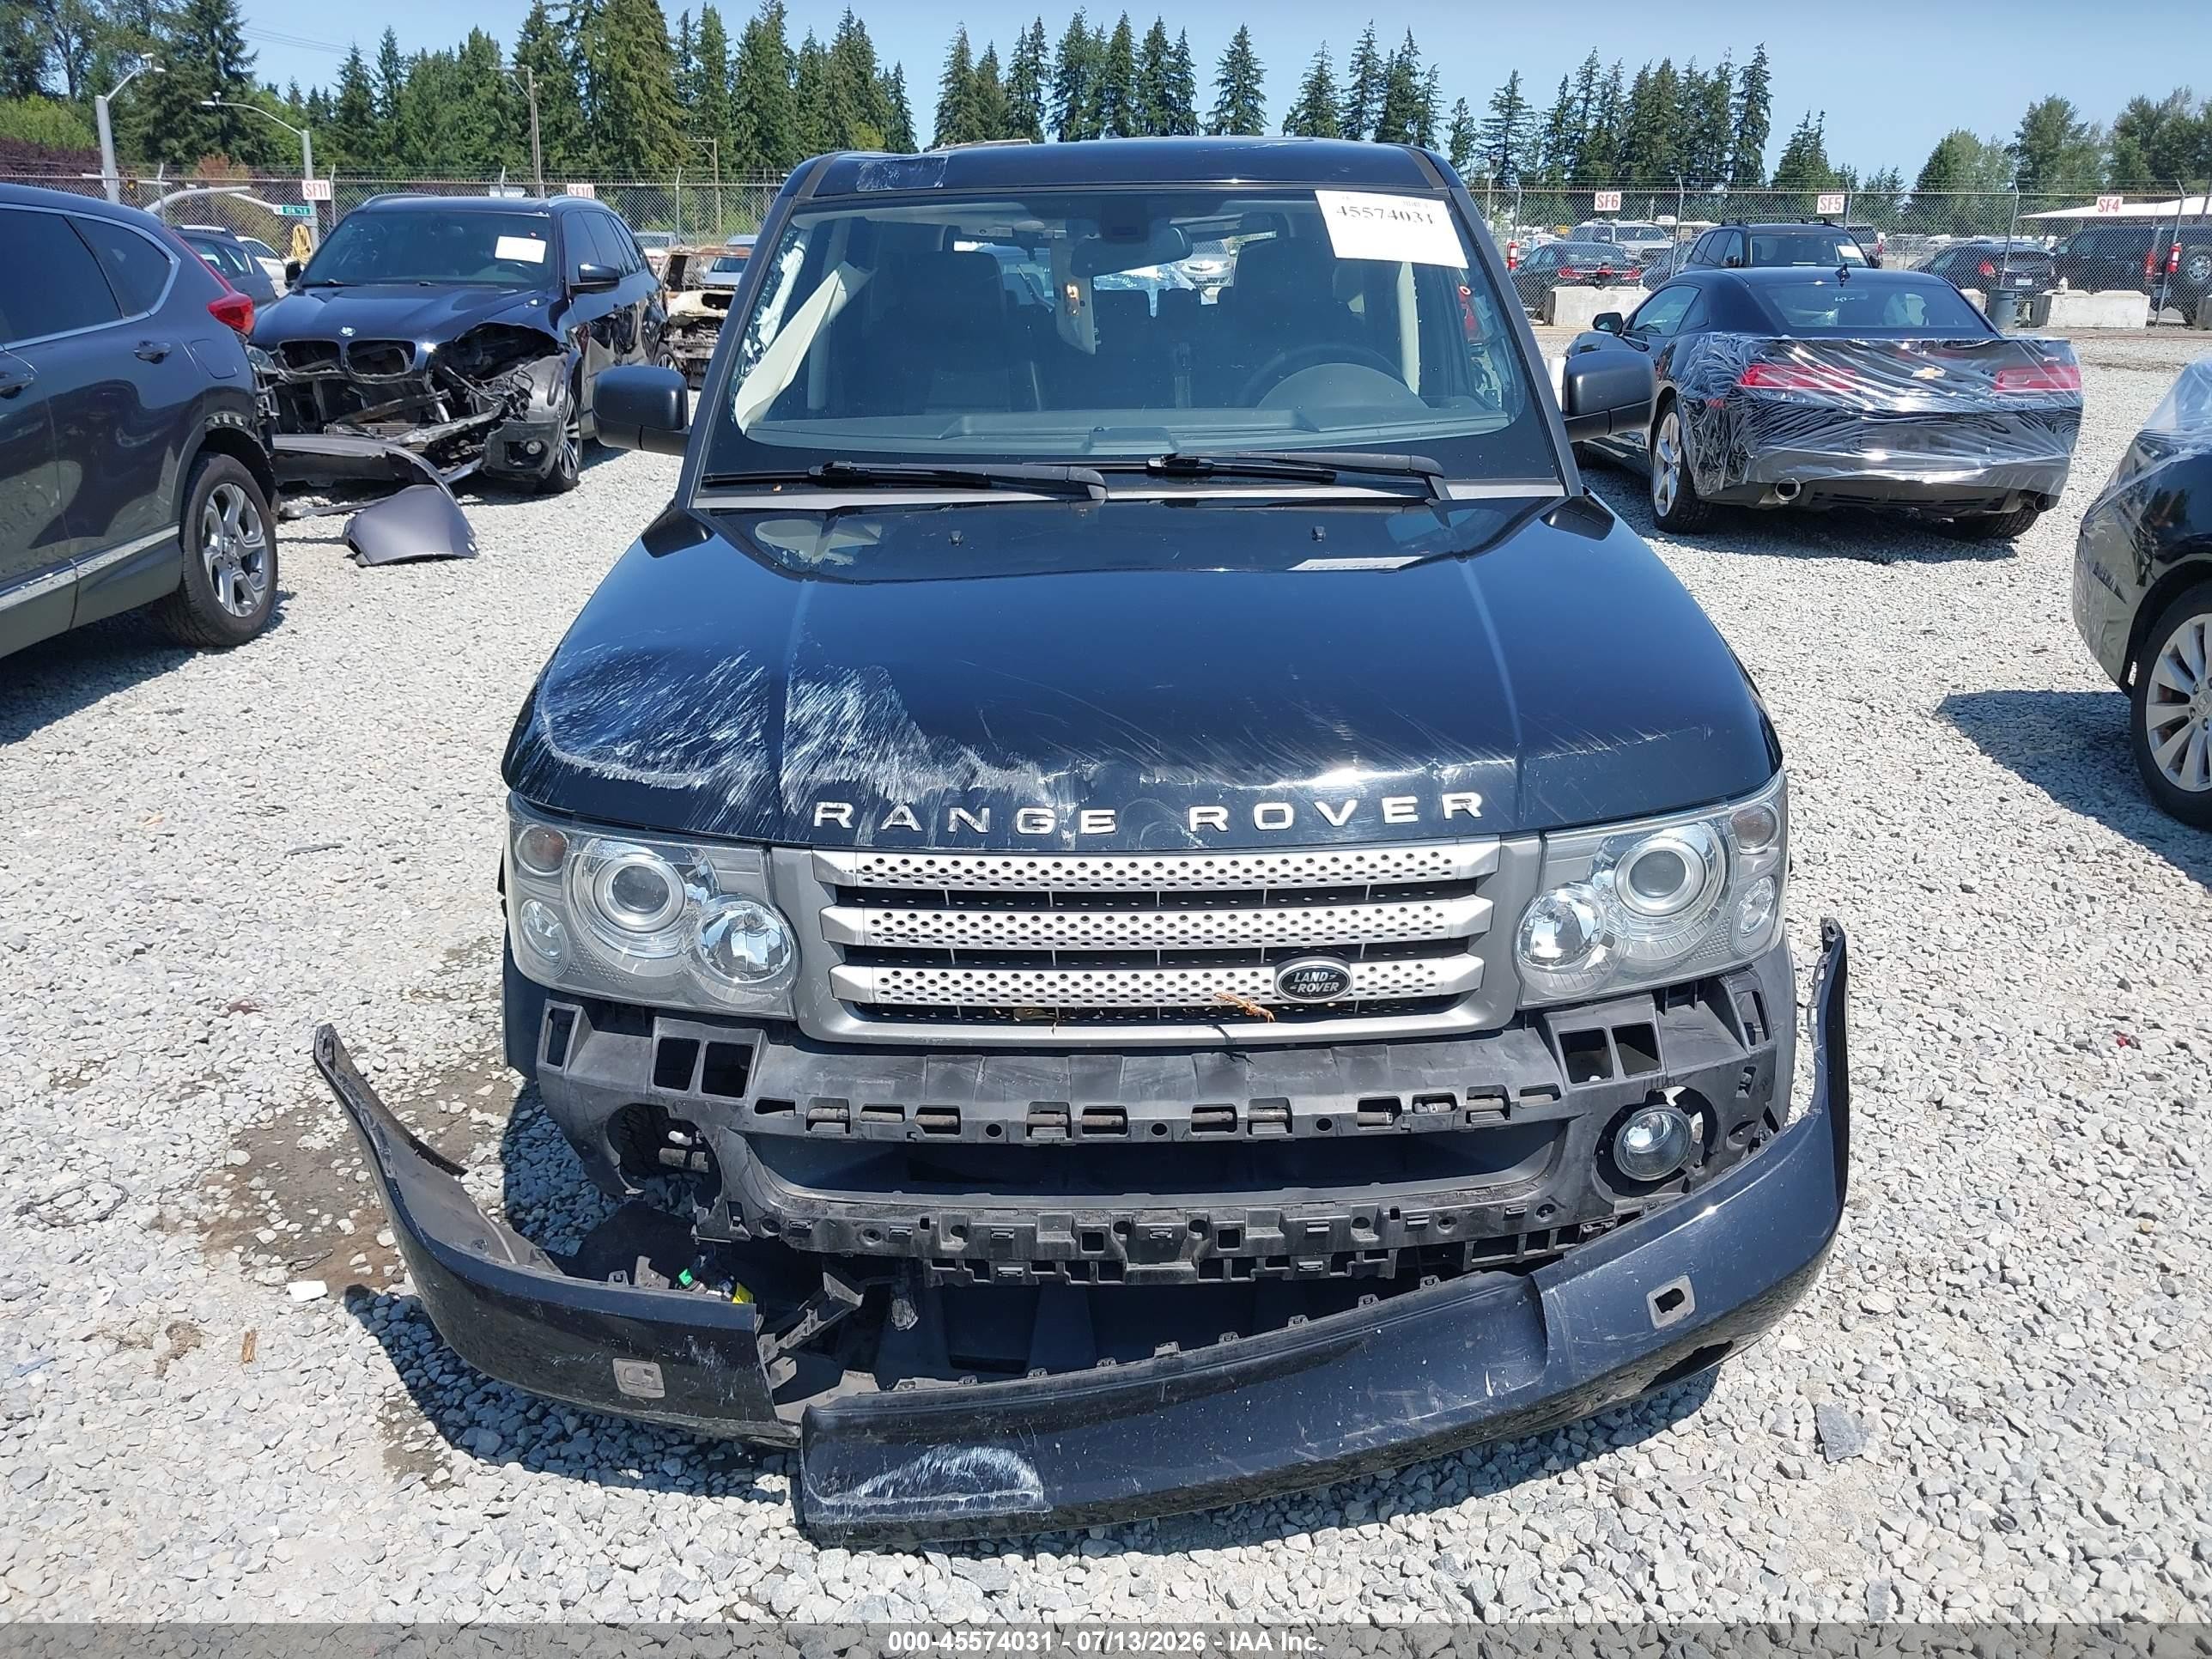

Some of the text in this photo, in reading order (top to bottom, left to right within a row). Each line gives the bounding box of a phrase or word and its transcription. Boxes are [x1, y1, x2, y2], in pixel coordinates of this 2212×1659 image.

[305, 182, 327, 198] SF11
[1597, 194, 1620, 209] SF6
[1820, 197, 1842, 211] SF5
[2098, 198, 2120, 212] SF4
[1336, 205, 1433, 224] 45574031
[813, 792, 1484, 835] RANGE ROVER
[1294, 971, 1329, 983] LAND
[1297, 981, 1340, 993] ROVER
